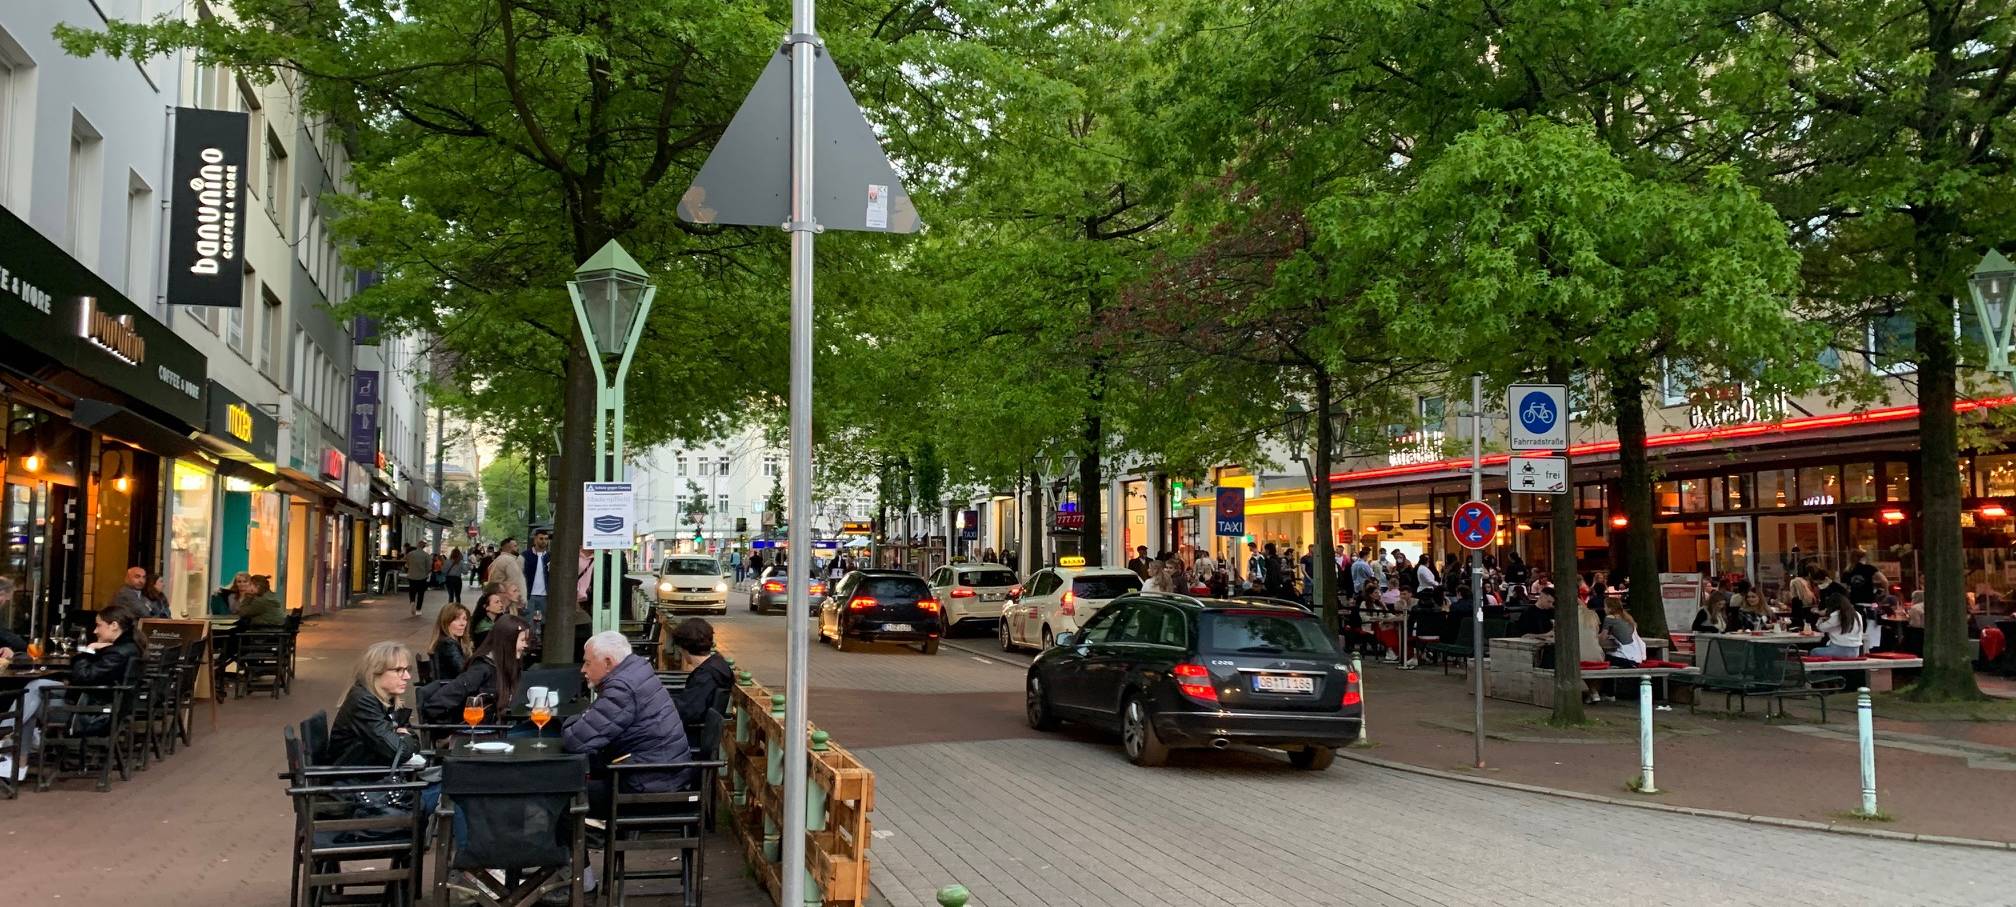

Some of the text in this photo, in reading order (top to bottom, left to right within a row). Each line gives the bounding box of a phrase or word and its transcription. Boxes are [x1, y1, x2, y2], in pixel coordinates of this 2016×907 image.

[226, 165, 238, 198] MORE
[190, 148, 223, 274] banunino
[222, 212, 235, 260] COFFEE
[22, 280, 52, 315] MORE
[158, 365, 180, 390] COFFEE
[1513, 437, 1564, 446] Fahrradstraße
[1545, 470, 1561, 480] frei
[1217, 521, 1243, 533] TAXI
